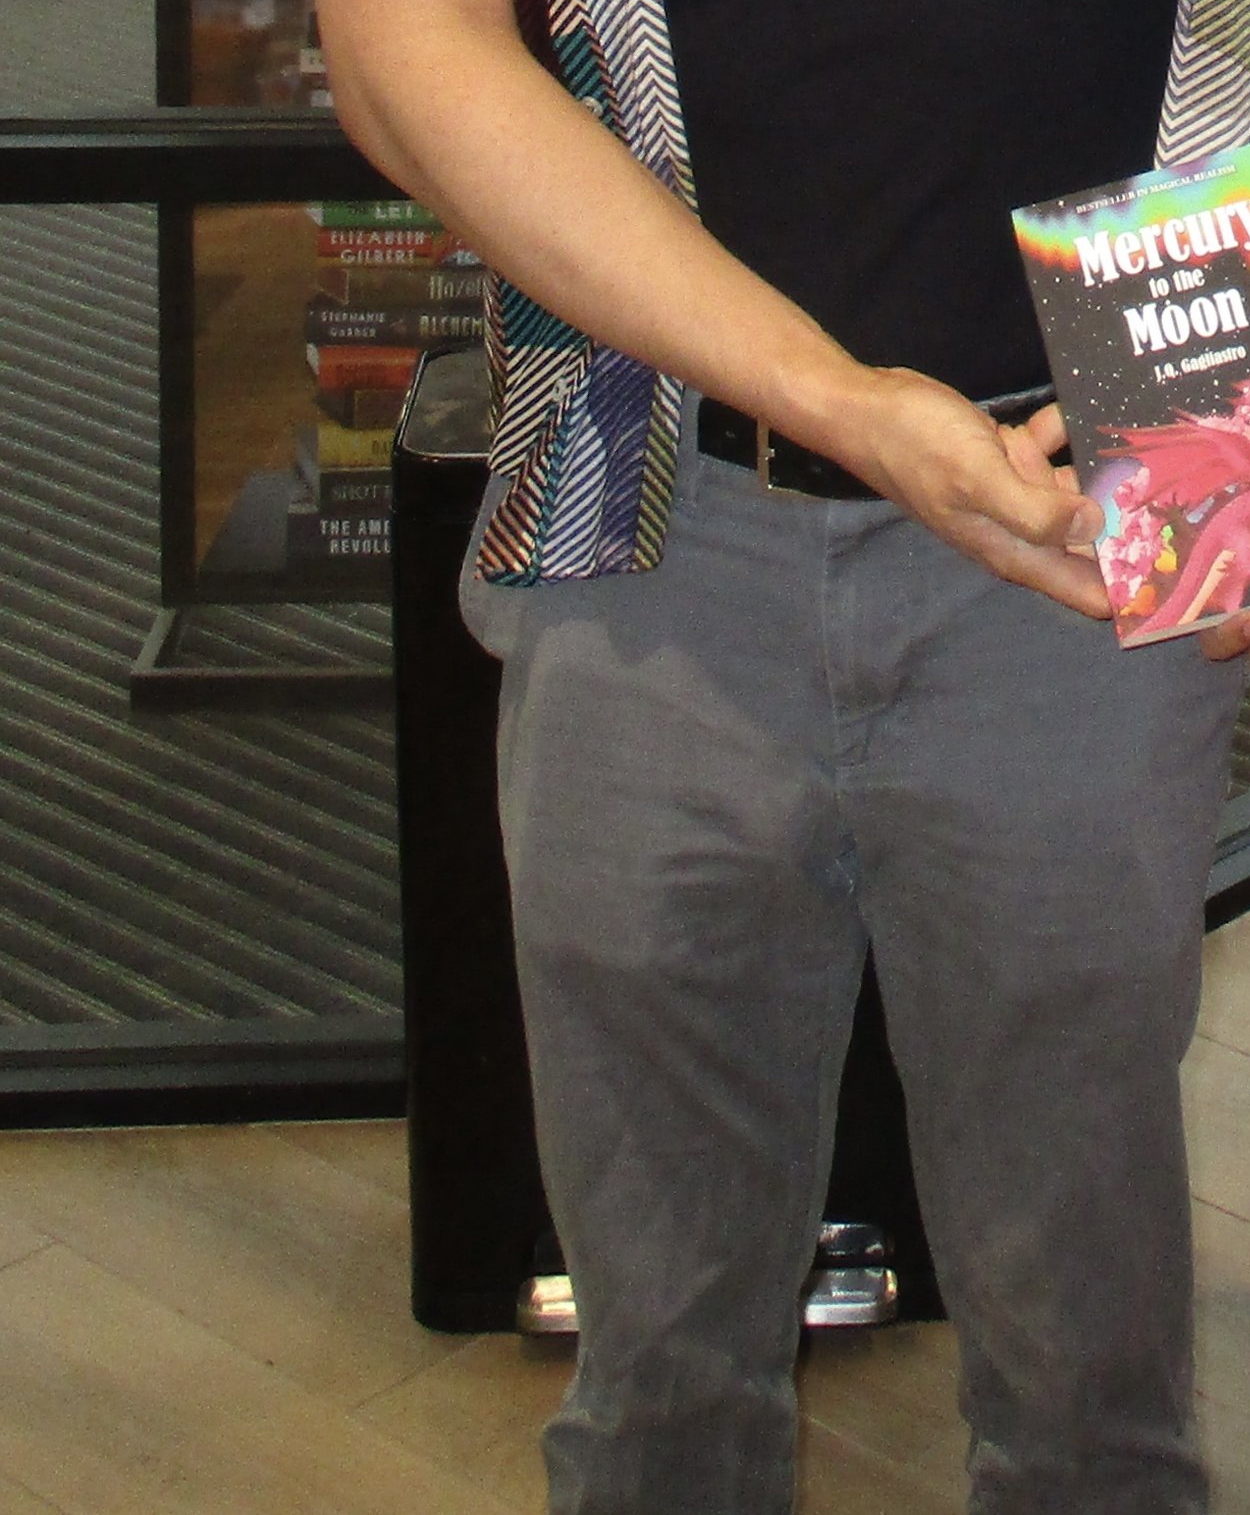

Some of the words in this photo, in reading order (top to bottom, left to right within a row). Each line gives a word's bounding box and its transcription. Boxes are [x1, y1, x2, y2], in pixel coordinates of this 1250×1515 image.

[1075, 191, 1136, 214] BESTSELLER
[1136, 186, 1149, 199] IN
[1149, 175, 1194, 195] MAGICAL
[1194, 164, 1237, 183] REALISM
[330, 230, 427, 246] ELIZABETH
[340, 249, 415, 264] GILBERT
[429, 274, 483, 300] Hazel
[1148, 276, 1171, 299] to
[1171, 267, 1207, 293] the
[320, 311, 386, 324] STEPHANIE
[418, 315, 484, 337] ALCHEM
[1123, 287, 1250, 358] Moon
[1153, 360, 1182, 383] J.Q.
[1179, 344, 1248, 373] Gagliastro
[319, 519, 350, 536] THE
[358, 519, 392, 536] AME
[330, 539, 392, 555] REVOLU
